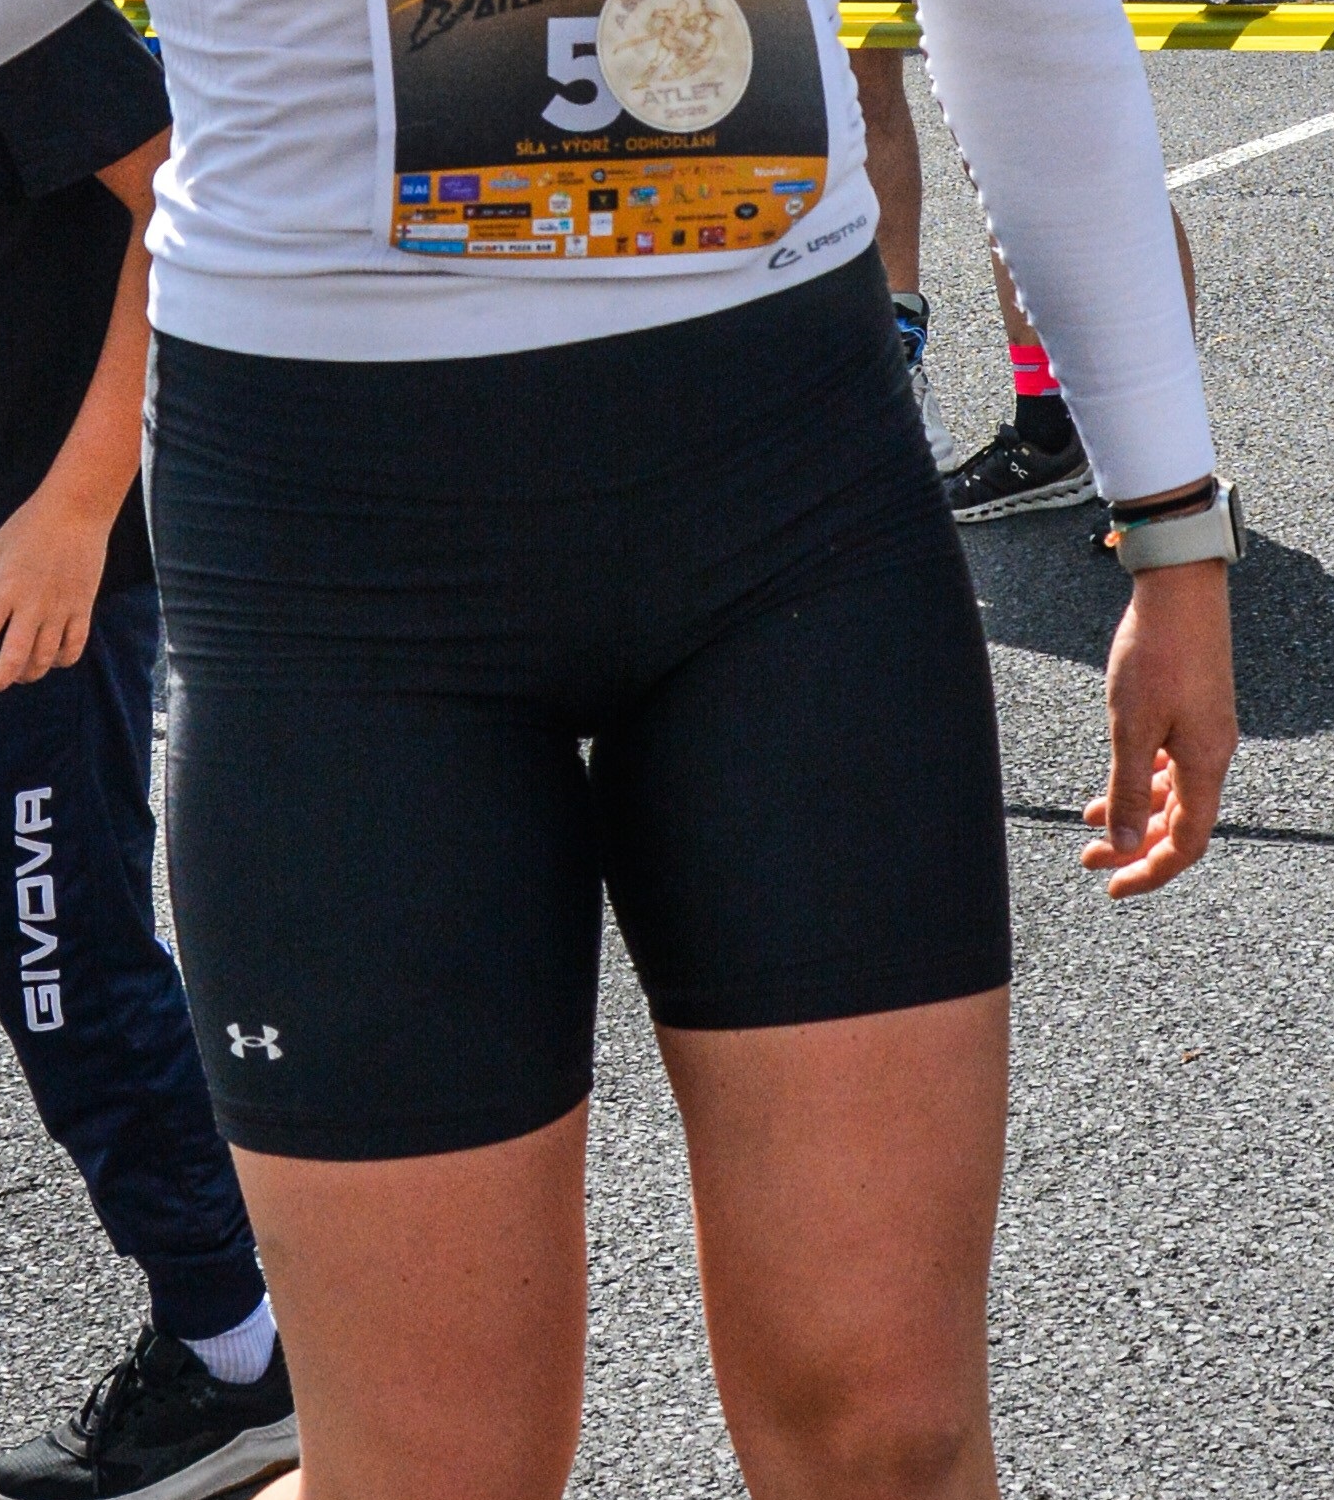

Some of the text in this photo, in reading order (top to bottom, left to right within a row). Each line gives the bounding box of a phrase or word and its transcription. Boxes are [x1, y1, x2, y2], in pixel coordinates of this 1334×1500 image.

[642, 81, 724, 107] ATLET
[516, 139, 546, 156] SÍLA
[14, 786, 64, 1033] GIVOVA
